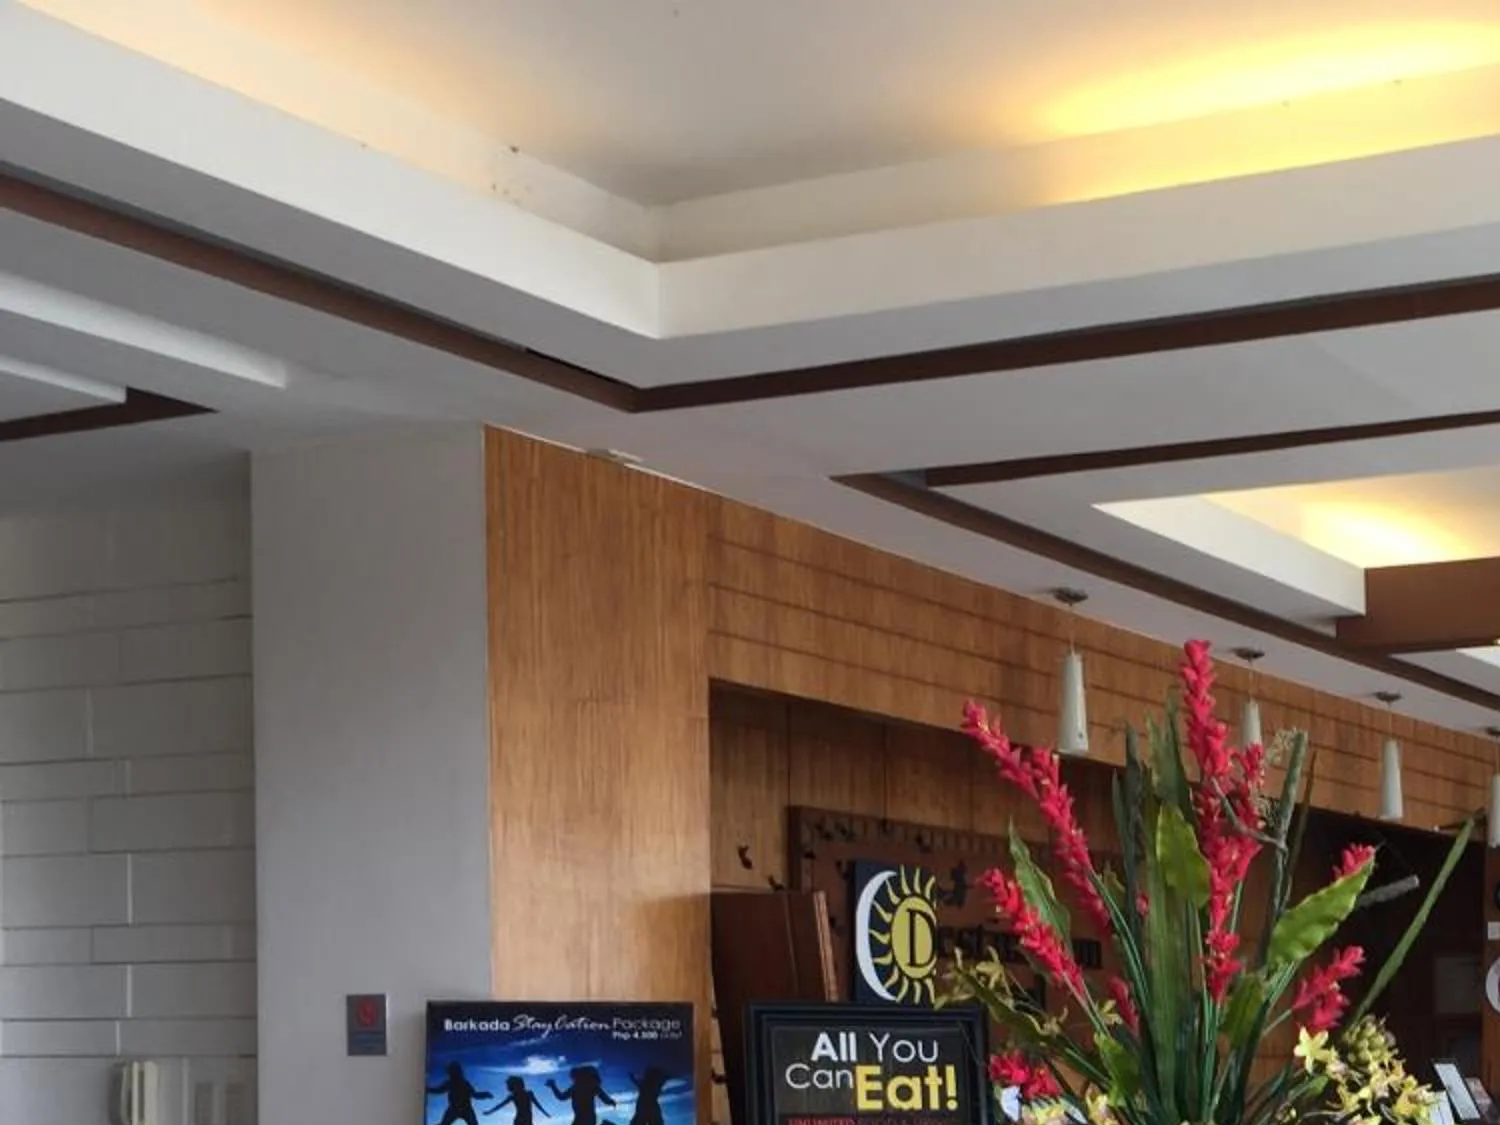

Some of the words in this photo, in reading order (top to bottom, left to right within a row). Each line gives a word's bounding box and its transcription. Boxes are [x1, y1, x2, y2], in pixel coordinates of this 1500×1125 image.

[444, 1018, 510, 1031] Barkada
[612, 1017, 681, 1032] Package
[810, 1031, 858, 1062] All
[869, 1032, 939, 1062] You
[785, 1063, 854, 1089] Can
[855, 1064, 958, 1111] Eat!
